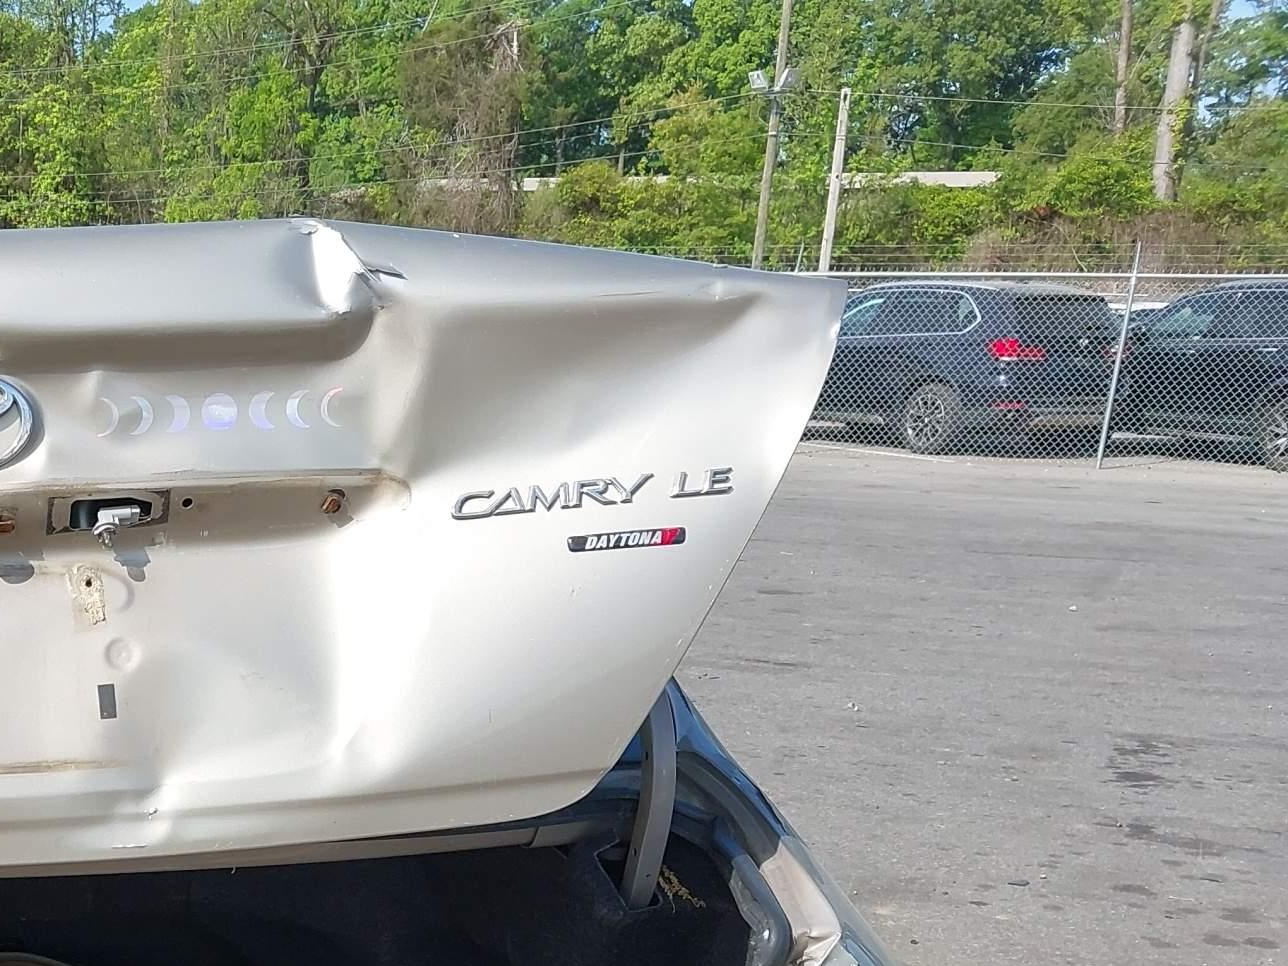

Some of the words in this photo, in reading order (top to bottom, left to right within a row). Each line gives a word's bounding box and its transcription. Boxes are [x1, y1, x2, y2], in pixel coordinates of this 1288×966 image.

[450, 472, 655, 520] CAMRY
[669, 466, 735, 498] LE
[584, 530, 663, 550] DAYTONA
